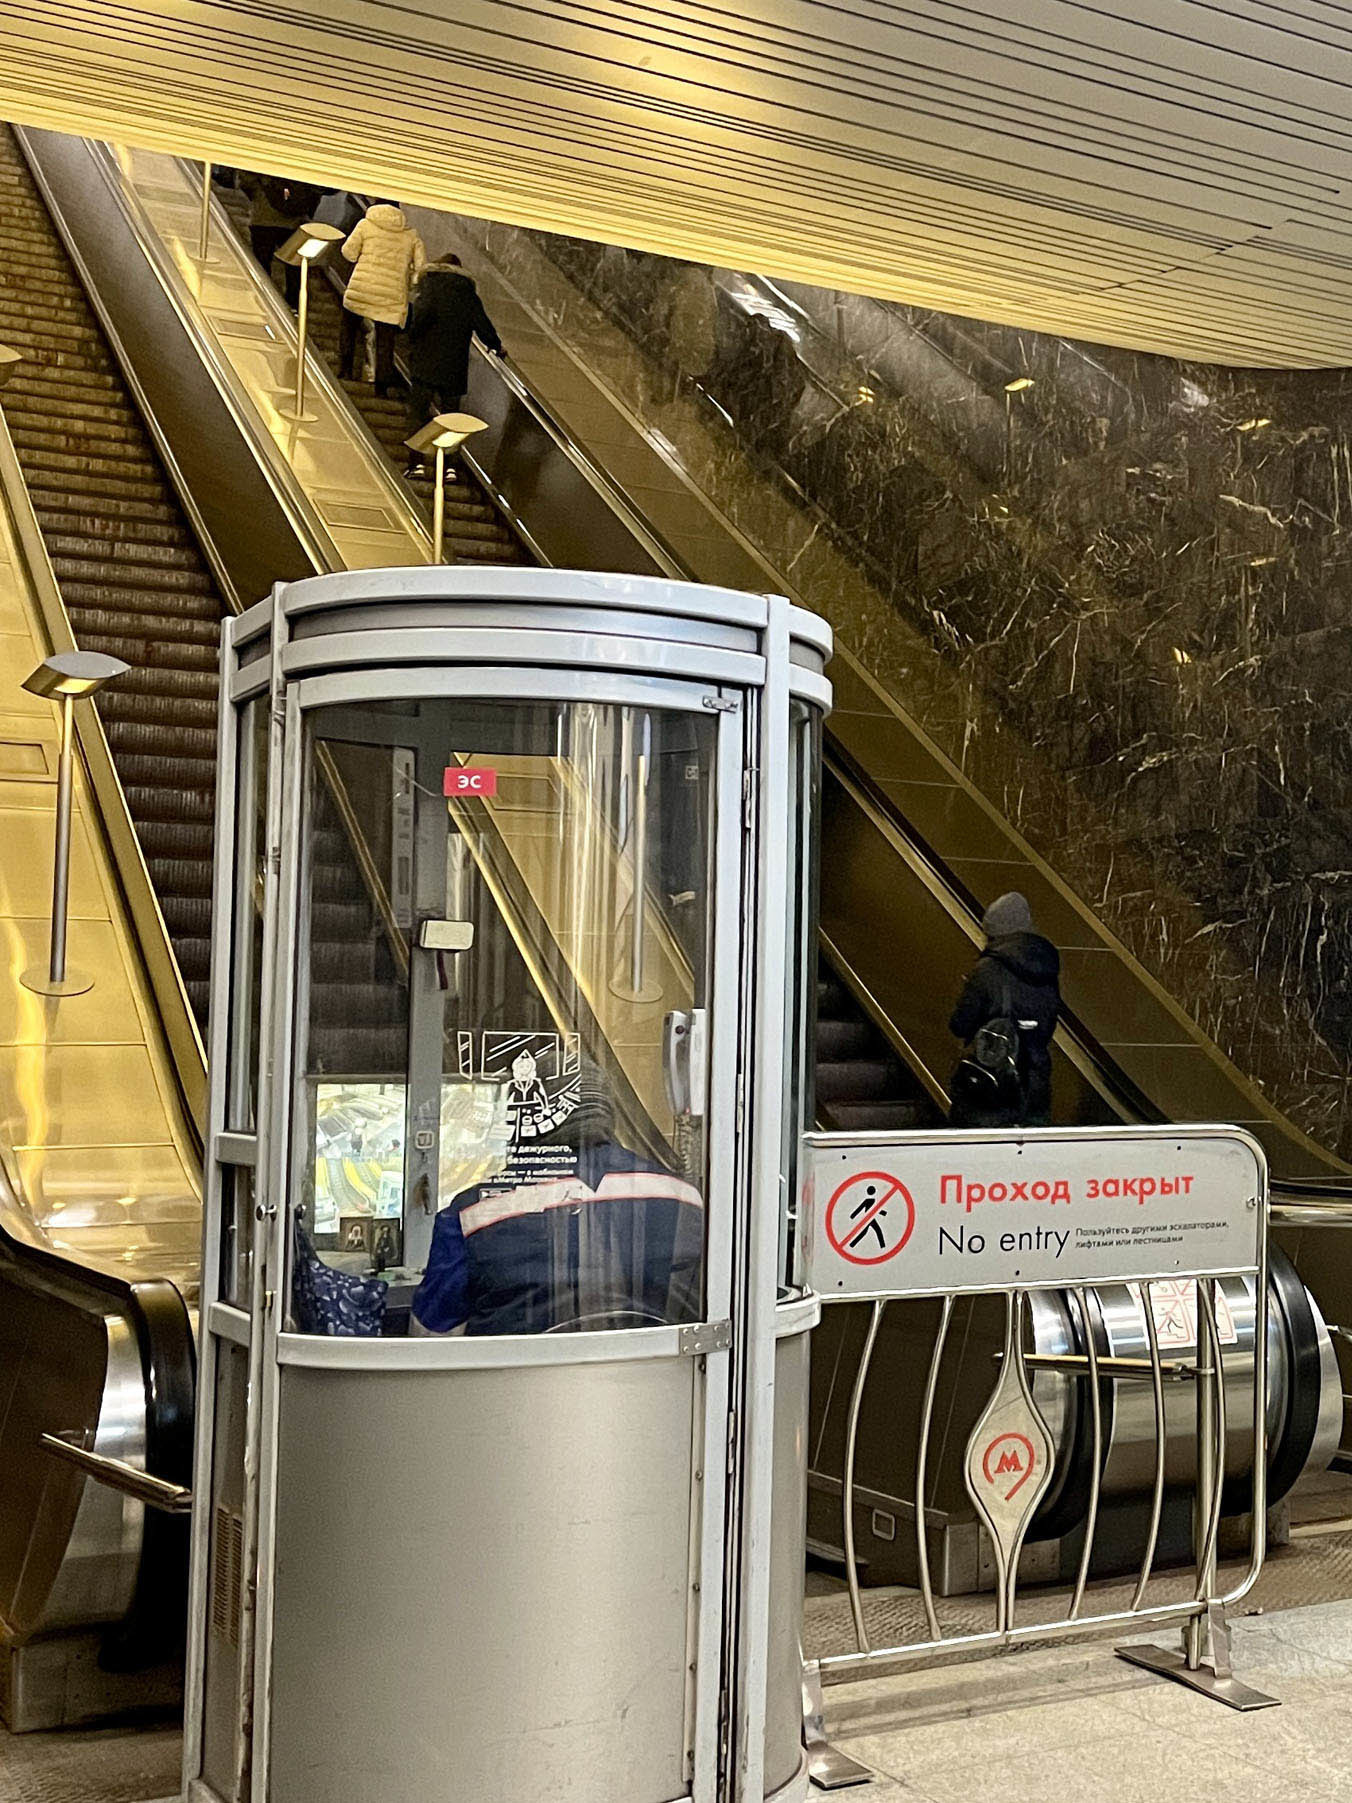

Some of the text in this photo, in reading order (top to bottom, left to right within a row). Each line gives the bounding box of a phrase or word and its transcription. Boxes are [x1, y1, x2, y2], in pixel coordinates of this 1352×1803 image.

[457, 775, 482, 788] ЭС
[517, 1145, 573, 1155] дежурного,
[506, 1154, 578, 1164] безопасностью
[939, 1174, 1194, 1213] Проход закрыт
[1075, 1226, 1130, 1237] Пользуйтесь
[1131, 1225, 1168, 1235] другими
[938, 1224, 1071, 1259] No entry
[1075, 1235, 1184, 1250] лифтами или лестницами
